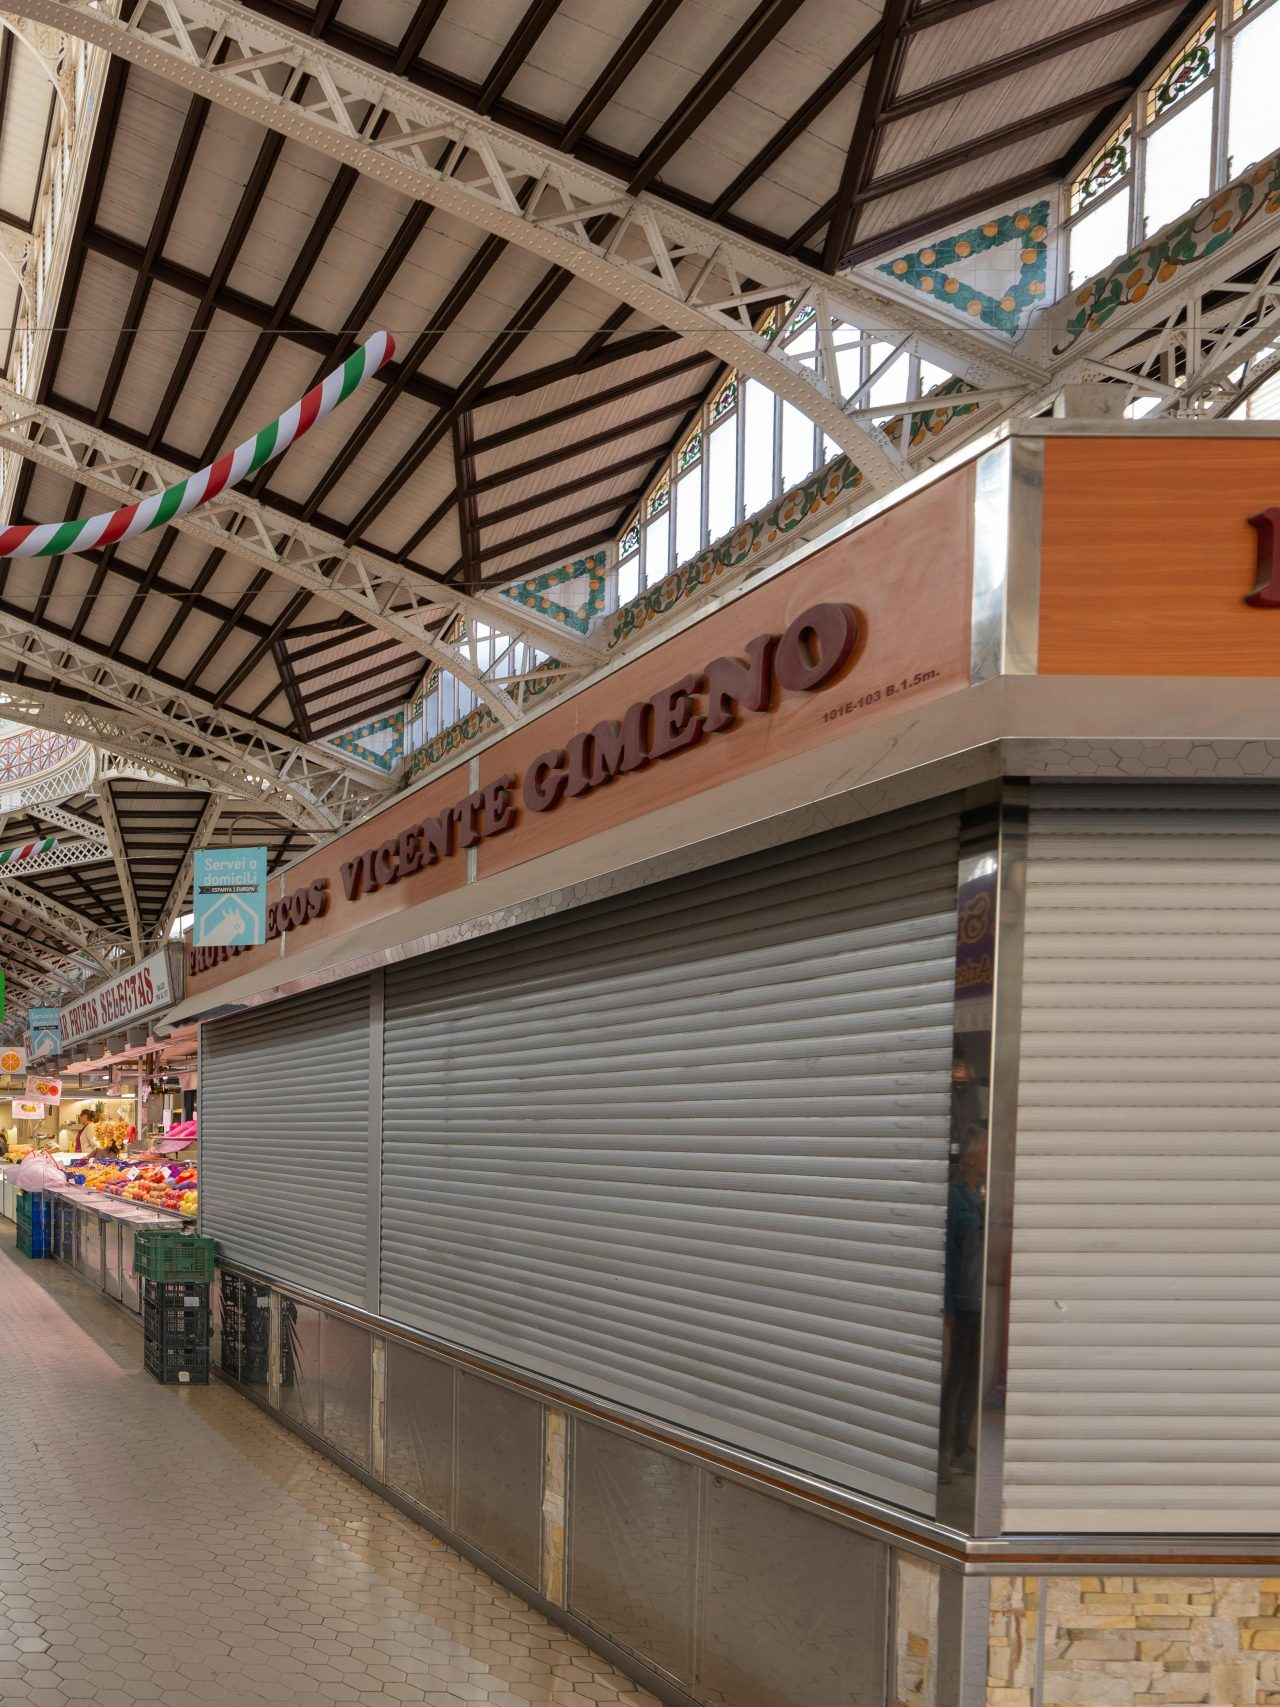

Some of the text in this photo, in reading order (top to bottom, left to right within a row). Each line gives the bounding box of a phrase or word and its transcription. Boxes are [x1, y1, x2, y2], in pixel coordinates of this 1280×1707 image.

[822, 669, 940, 723] 101E-103 B.1.5m.
[340, 602, 866, 902] VICENTE GIMENO
[204, 857, 257, 872] Servei a
[204, 871, 257, 887] domicili
[237, 885, 255, 893] EUROPA
[266, 877, 331, 941] ECOS
[69, 997, 100, 1038] FRUTAS
[100, 966, 154, 1026] SELECTAS
